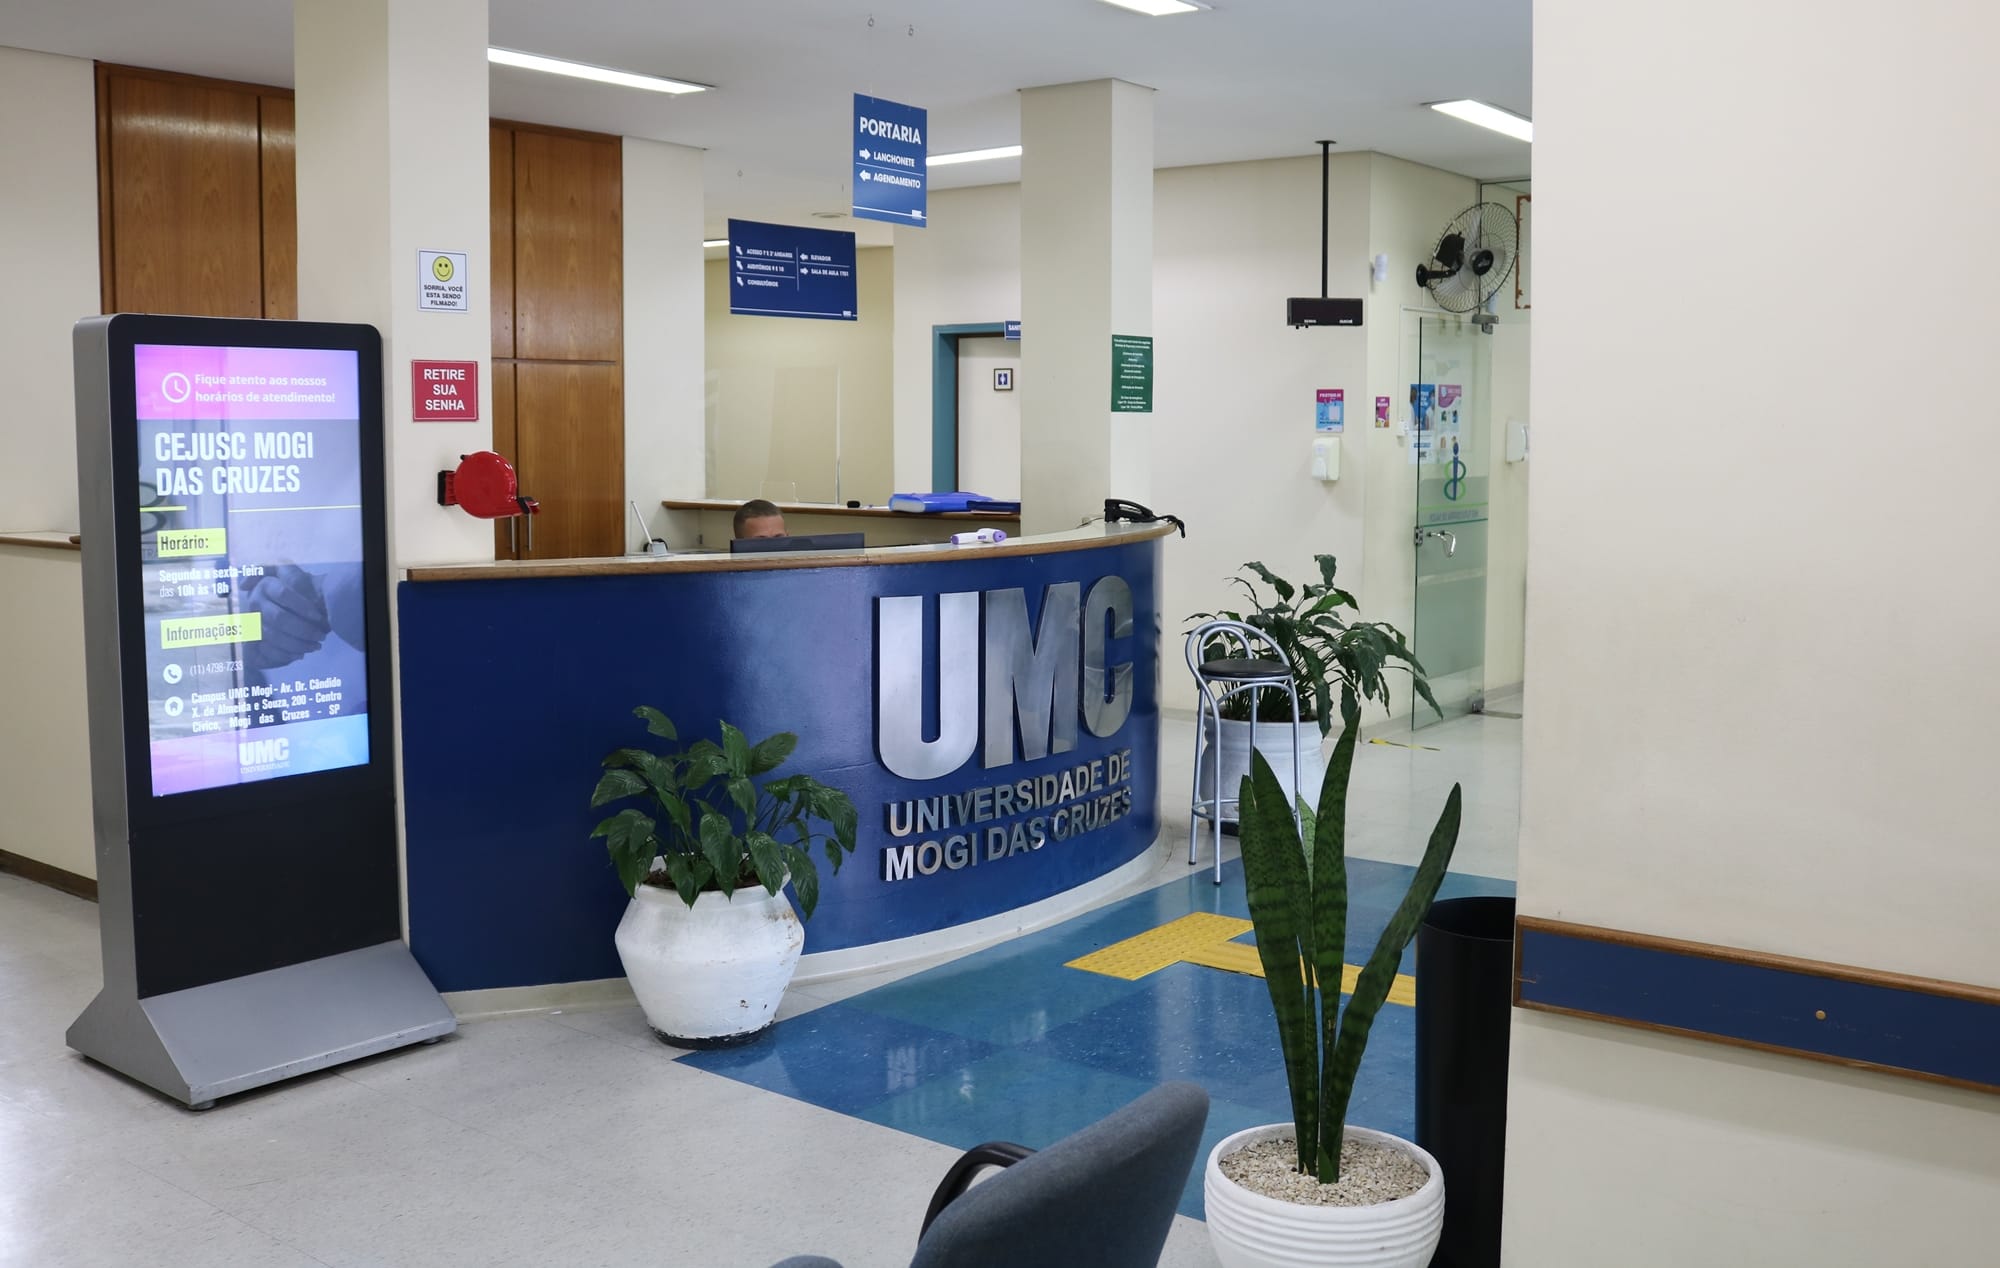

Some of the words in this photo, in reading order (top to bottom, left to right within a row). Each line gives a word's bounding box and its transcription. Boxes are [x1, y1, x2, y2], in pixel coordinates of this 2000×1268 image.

[860, 116, 922, 145] PORTARIA
[874, 152, 915, 167] LANCHONETE
[874, 173, 920, 189] AGENDAMENTO
[195, 374, 226, 388] Fique
[229, 375, 266, 386] atento
[269, 377, 287, 386] aos
[291, 376, 326, 386] nossos
[424, 368, 465, 380] RETIRE
[195, 390, 243, 402] horários
[247, 392, 259, 402] de
[262, 392, 335, 403] atendimento!
[433, 384, 457, 395] SUA
[425, 400, 465, 411] SENHA
[155, 432, 246, 461] CEJUSC
[254, 432, 313, 459] MOGI
[156, 466, 203, 496] DAS
[212, 465, 300, 495] CRUZES
[161, 535, 208, 550] Horário:
[160, 568, 202, 583] Segunda
[205, 570, 210, 579] a
[212, 565, 264, 578] sexta-feira
[160, 585, 174, 597] das
[177, 585, 194, 597] 10h
[197, 584, 209, 596] às
[212, 583, 229, 594] 18h
[167, 623, 242, 641] Informações:
[190, 663, 205, 676] (11)
[876, 575, 1134, 780] UMC
[191, 692, 226, 704] Campus
[228, 687, 249, 698] UMC
[251, 685, 273, 698] Mogi
[280, 683, 293, 694] Av.
[296, 681, 307, 691] Dr.
[309, 677, 341, 690] Cândido
[192, 708, 200, 718] X.
[204, 706, 215, 716] de
[217, 702, 251, 715] Almeida
[262, 697, 289, 710] Souza,
[291, 696, 306, 706] 200
[316, 691, 341, 703] Centro
[192, 720, 220, 733] Cívico,
[230, 716, 251, 729] Mogi
[259, 713, 274, 724] das
[282, 709, 310, 721] Cruzes
[329, 704, 340, 715] SP
[239, 738, 289, 765] UMC
[887, 760, 1102, 837] UNIVERSIDADE
[1108, 750, 1131, 782] DE
[882, 832, 978, 882] MOGI
[984, 817, 1046, 862] DAS
[1051, 789, 1132, 841] CRUZES
